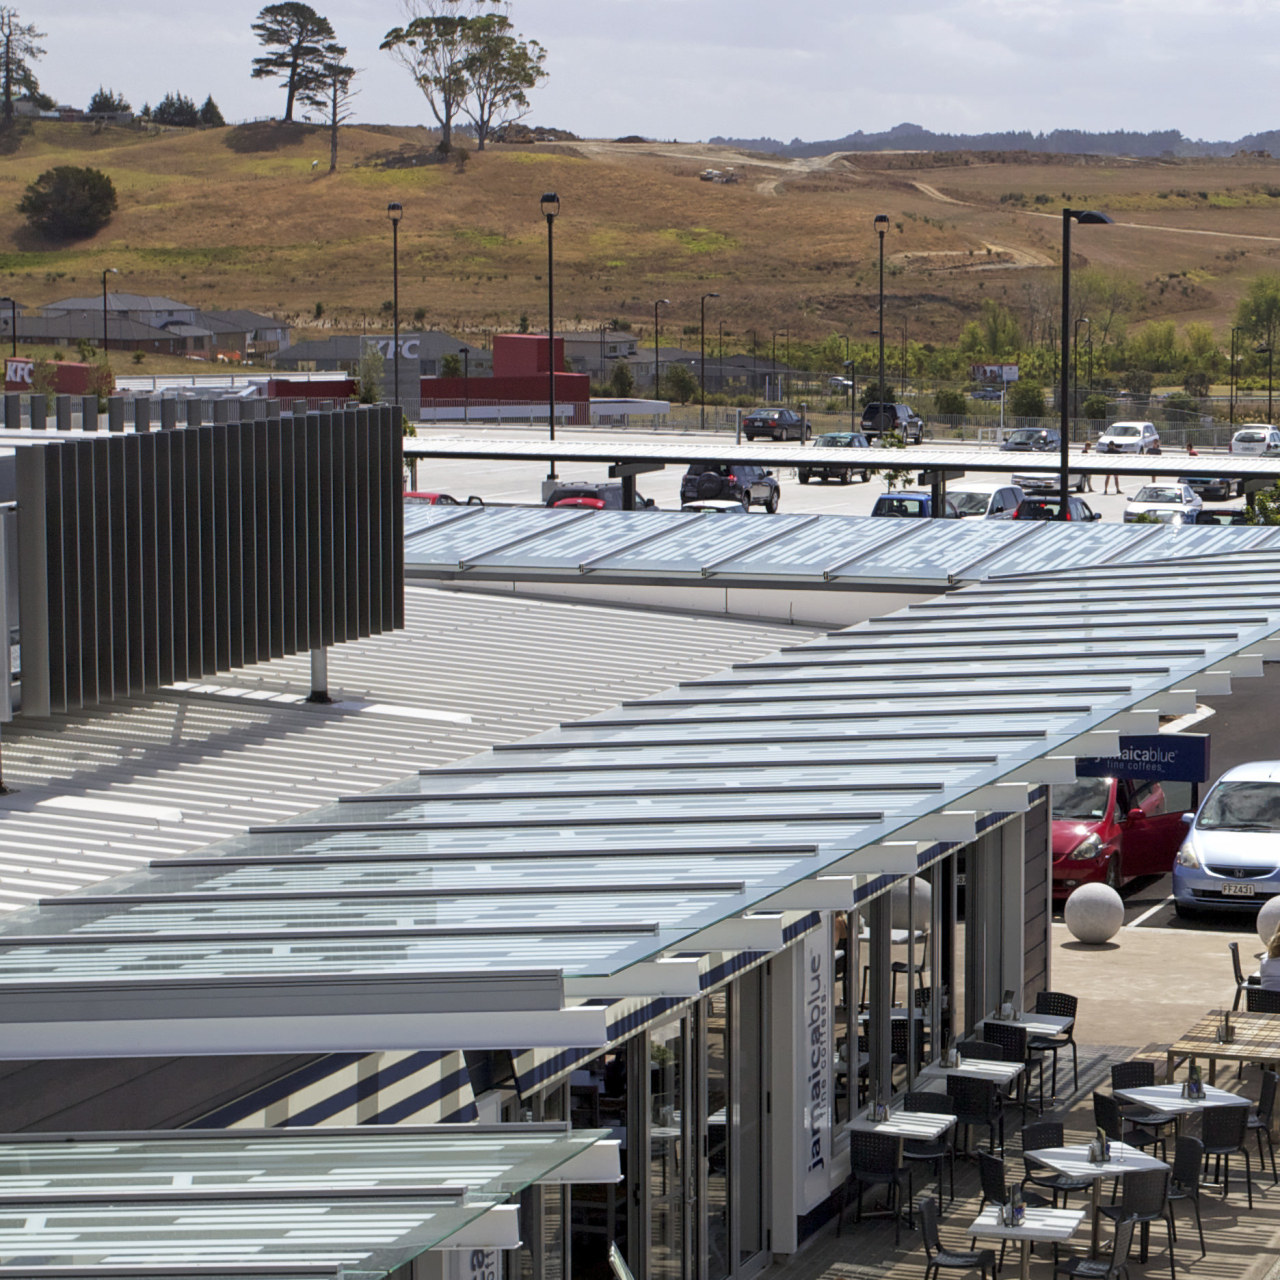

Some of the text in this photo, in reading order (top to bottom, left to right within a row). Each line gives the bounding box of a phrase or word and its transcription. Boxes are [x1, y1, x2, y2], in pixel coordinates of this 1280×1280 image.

[5, 362, 34, 384] KFC
[1107, 761, 1163, 772] fine coffees
[808, 953, 825, 1173] jamaicablue
